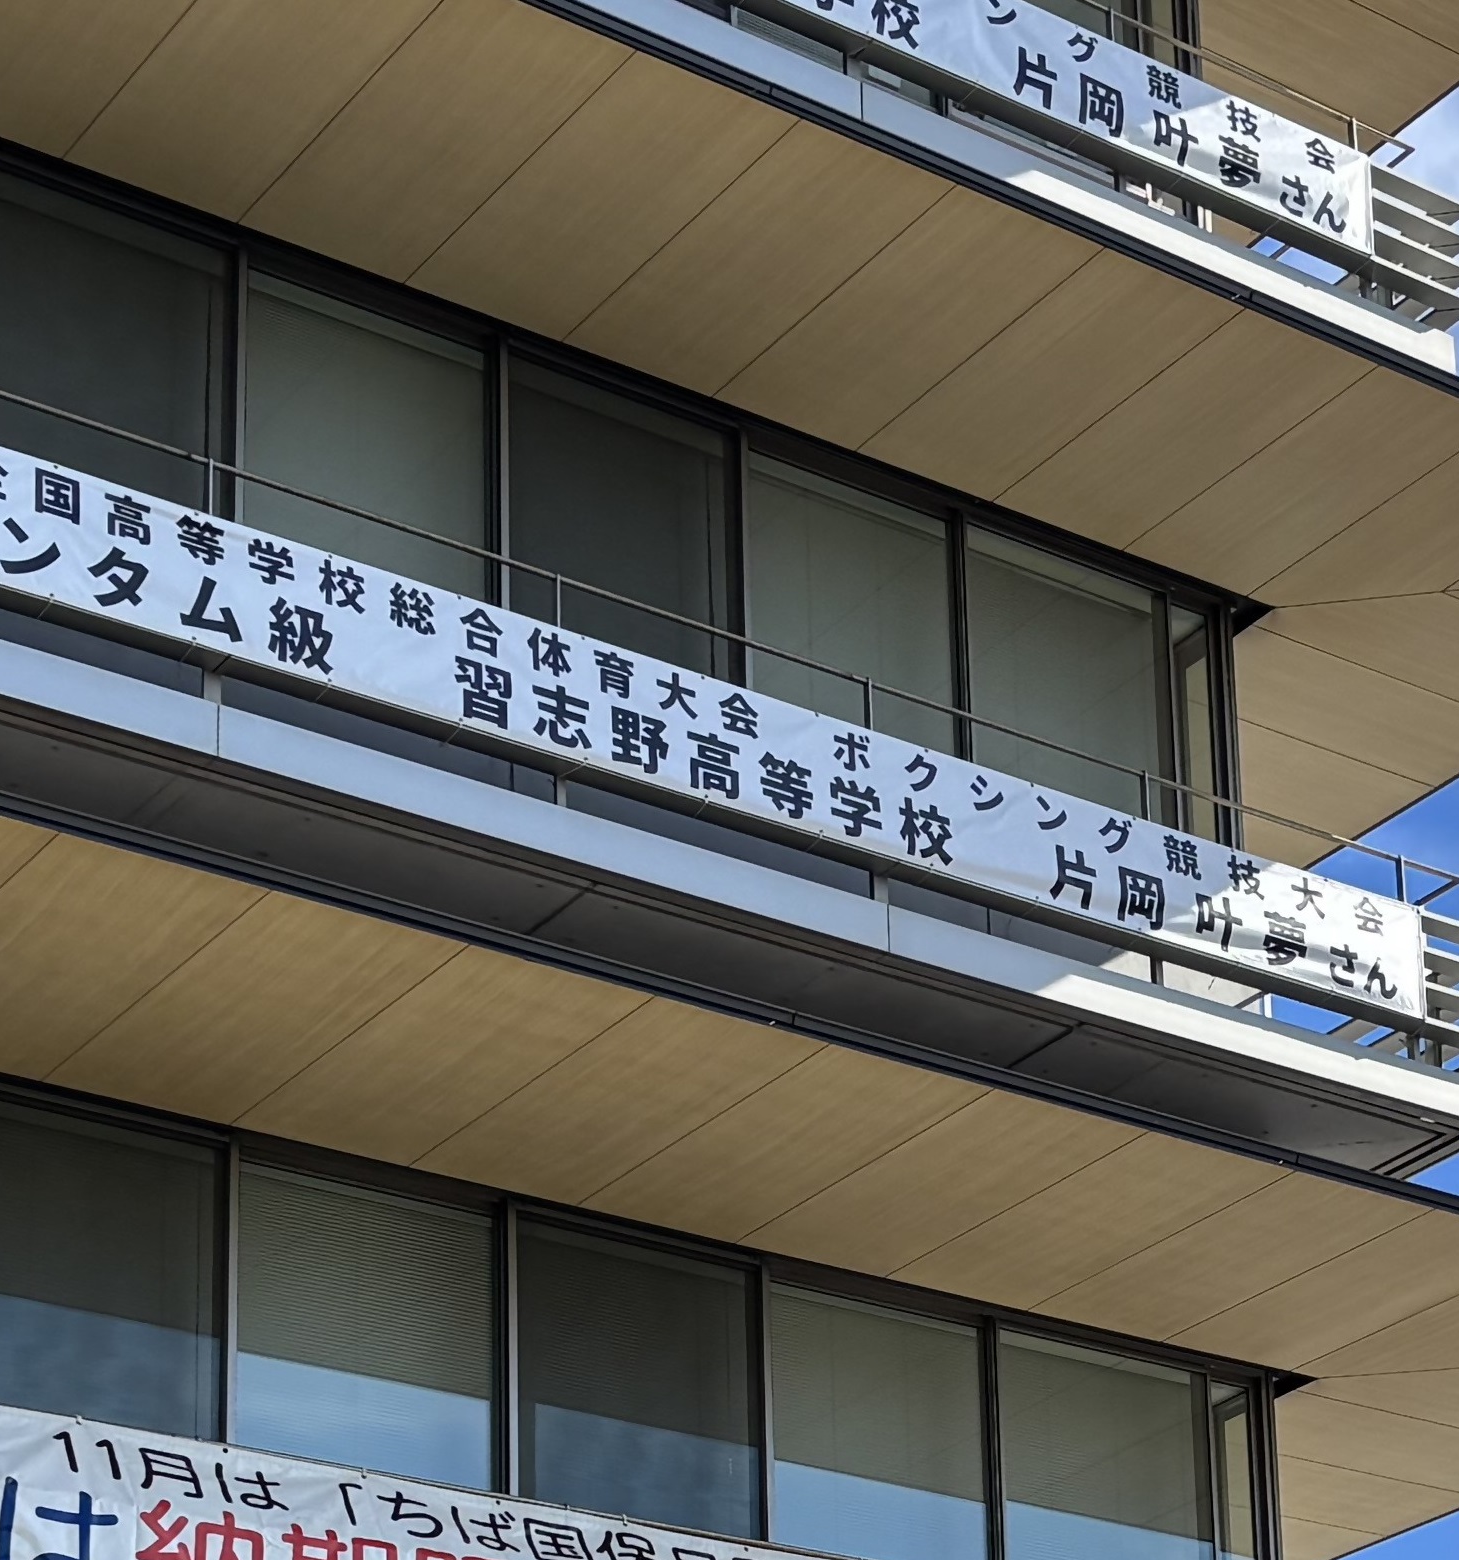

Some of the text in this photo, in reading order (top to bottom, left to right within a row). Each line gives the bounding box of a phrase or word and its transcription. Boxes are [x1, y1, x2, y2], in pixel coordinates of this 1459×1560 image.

[1013, 47, 1347, 235] 片岡叶夢さん
[454, 655, 954, 867] 習志野高等学校
[1049, 844, 1398, 1000] 片岡叶夢さん
[833, 732, 1385, 938] ボクシング競技大会
